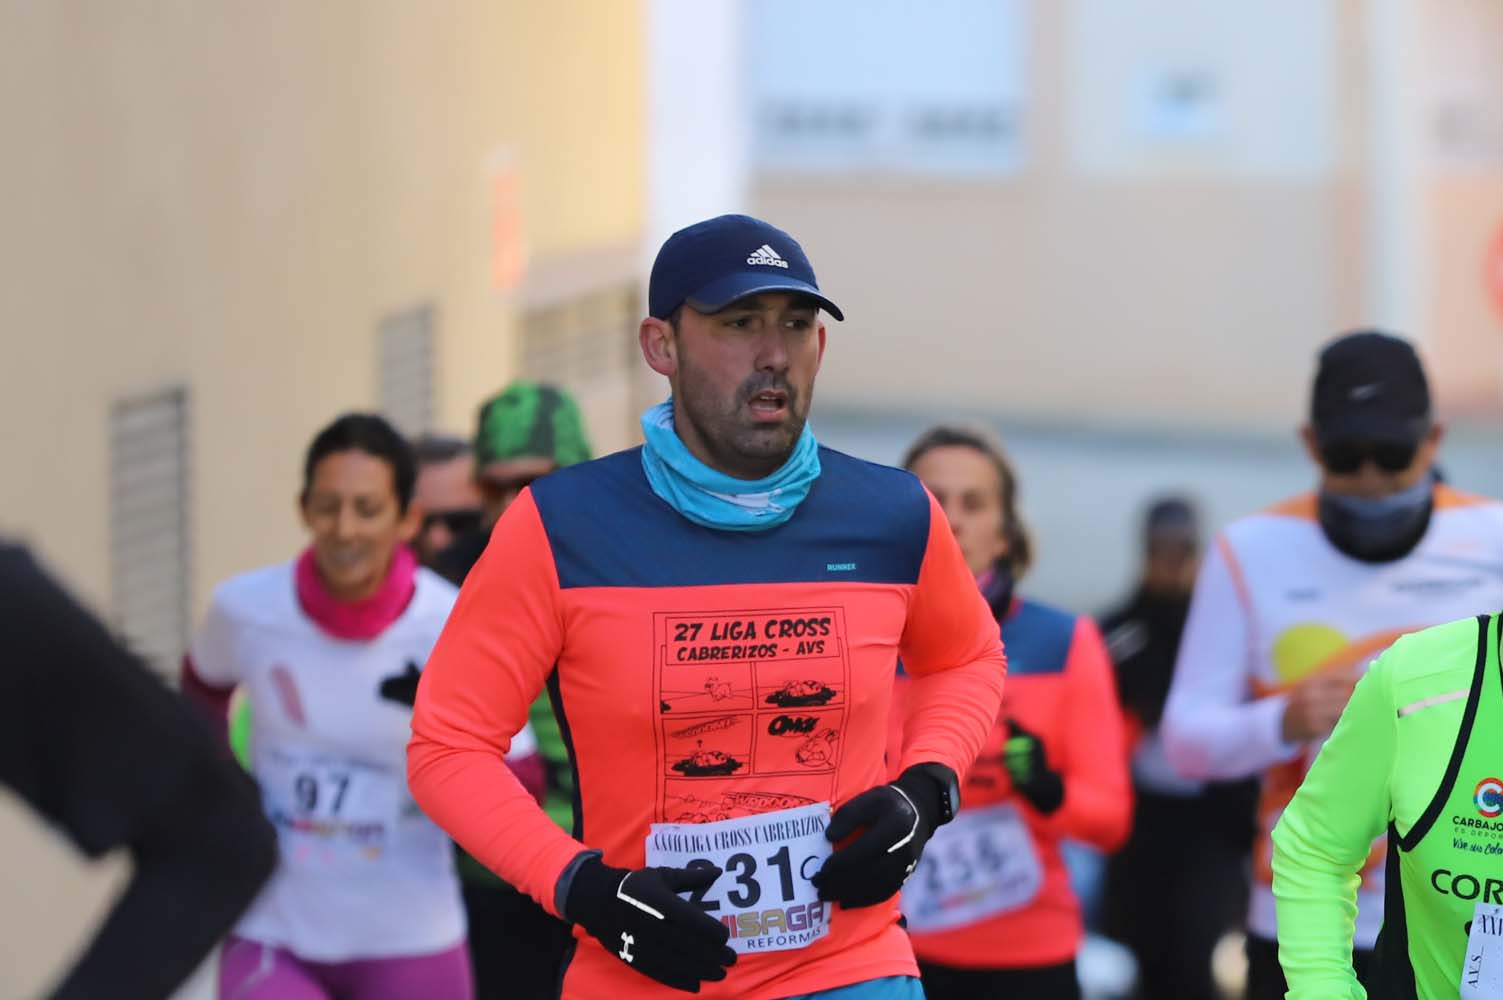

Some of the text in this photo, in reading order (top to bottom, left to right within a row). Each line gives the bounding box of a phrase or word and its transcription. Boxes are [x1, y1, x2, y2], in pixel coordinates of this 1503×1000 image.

[746, 257, 788, 269] adidas
[674, 617, 831, 642] 27 LIGA CROSS
[677, 643, 778, 661] CABRERIZOS
[796, 640, 825, 655] AVS
[296, 774, 349, 814] 97
[682, 836, 711, 853] LIGA
[714, 829, 754, 851] CROSS
[754, 815, 826, 845] CABRERIZOS
[747, 927, 822, 949] REFORMAS
